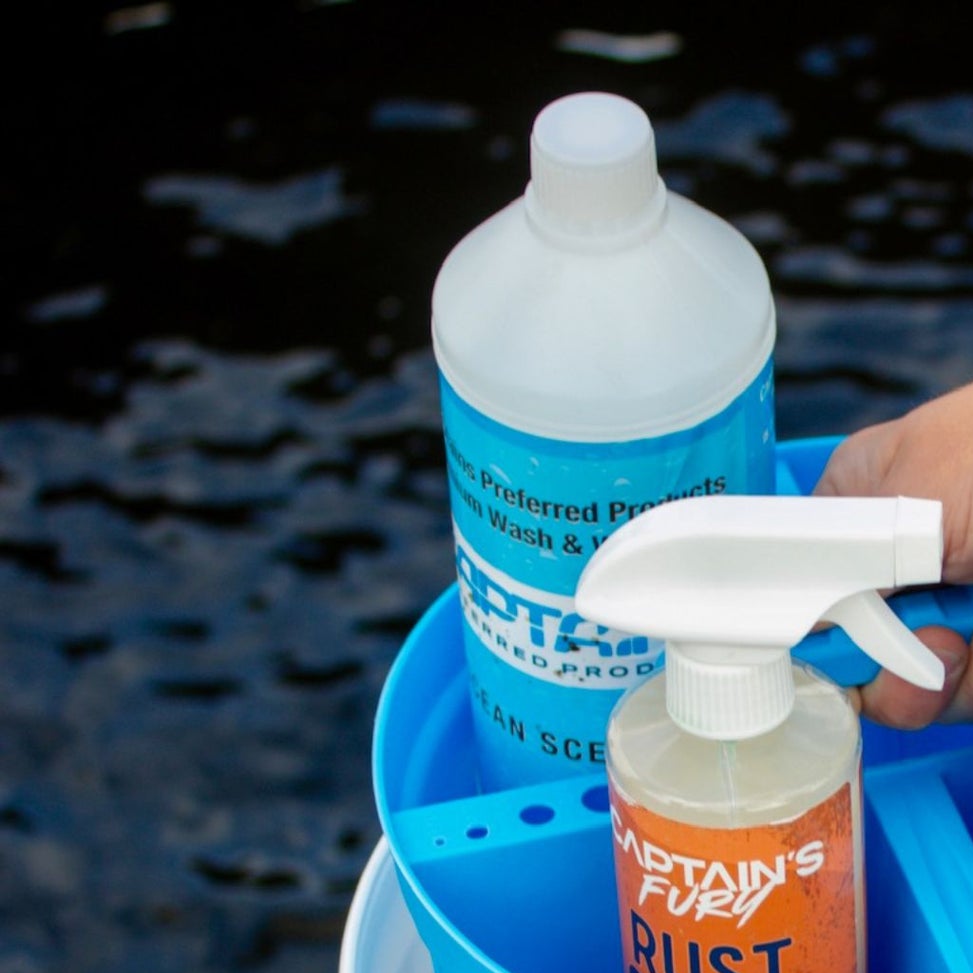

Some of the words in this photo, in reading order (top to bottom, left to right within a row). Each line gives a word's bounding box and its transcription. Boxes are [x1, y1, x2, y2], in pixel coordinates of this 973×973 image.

[481, 469, 598, 523] Preferred
[488, 505, 553, 551] Wash
[562, 533, 582, 554] &
[610, 803, 825, 893] CAPTAIN'S
[638, 873, 778, 929] FURY
